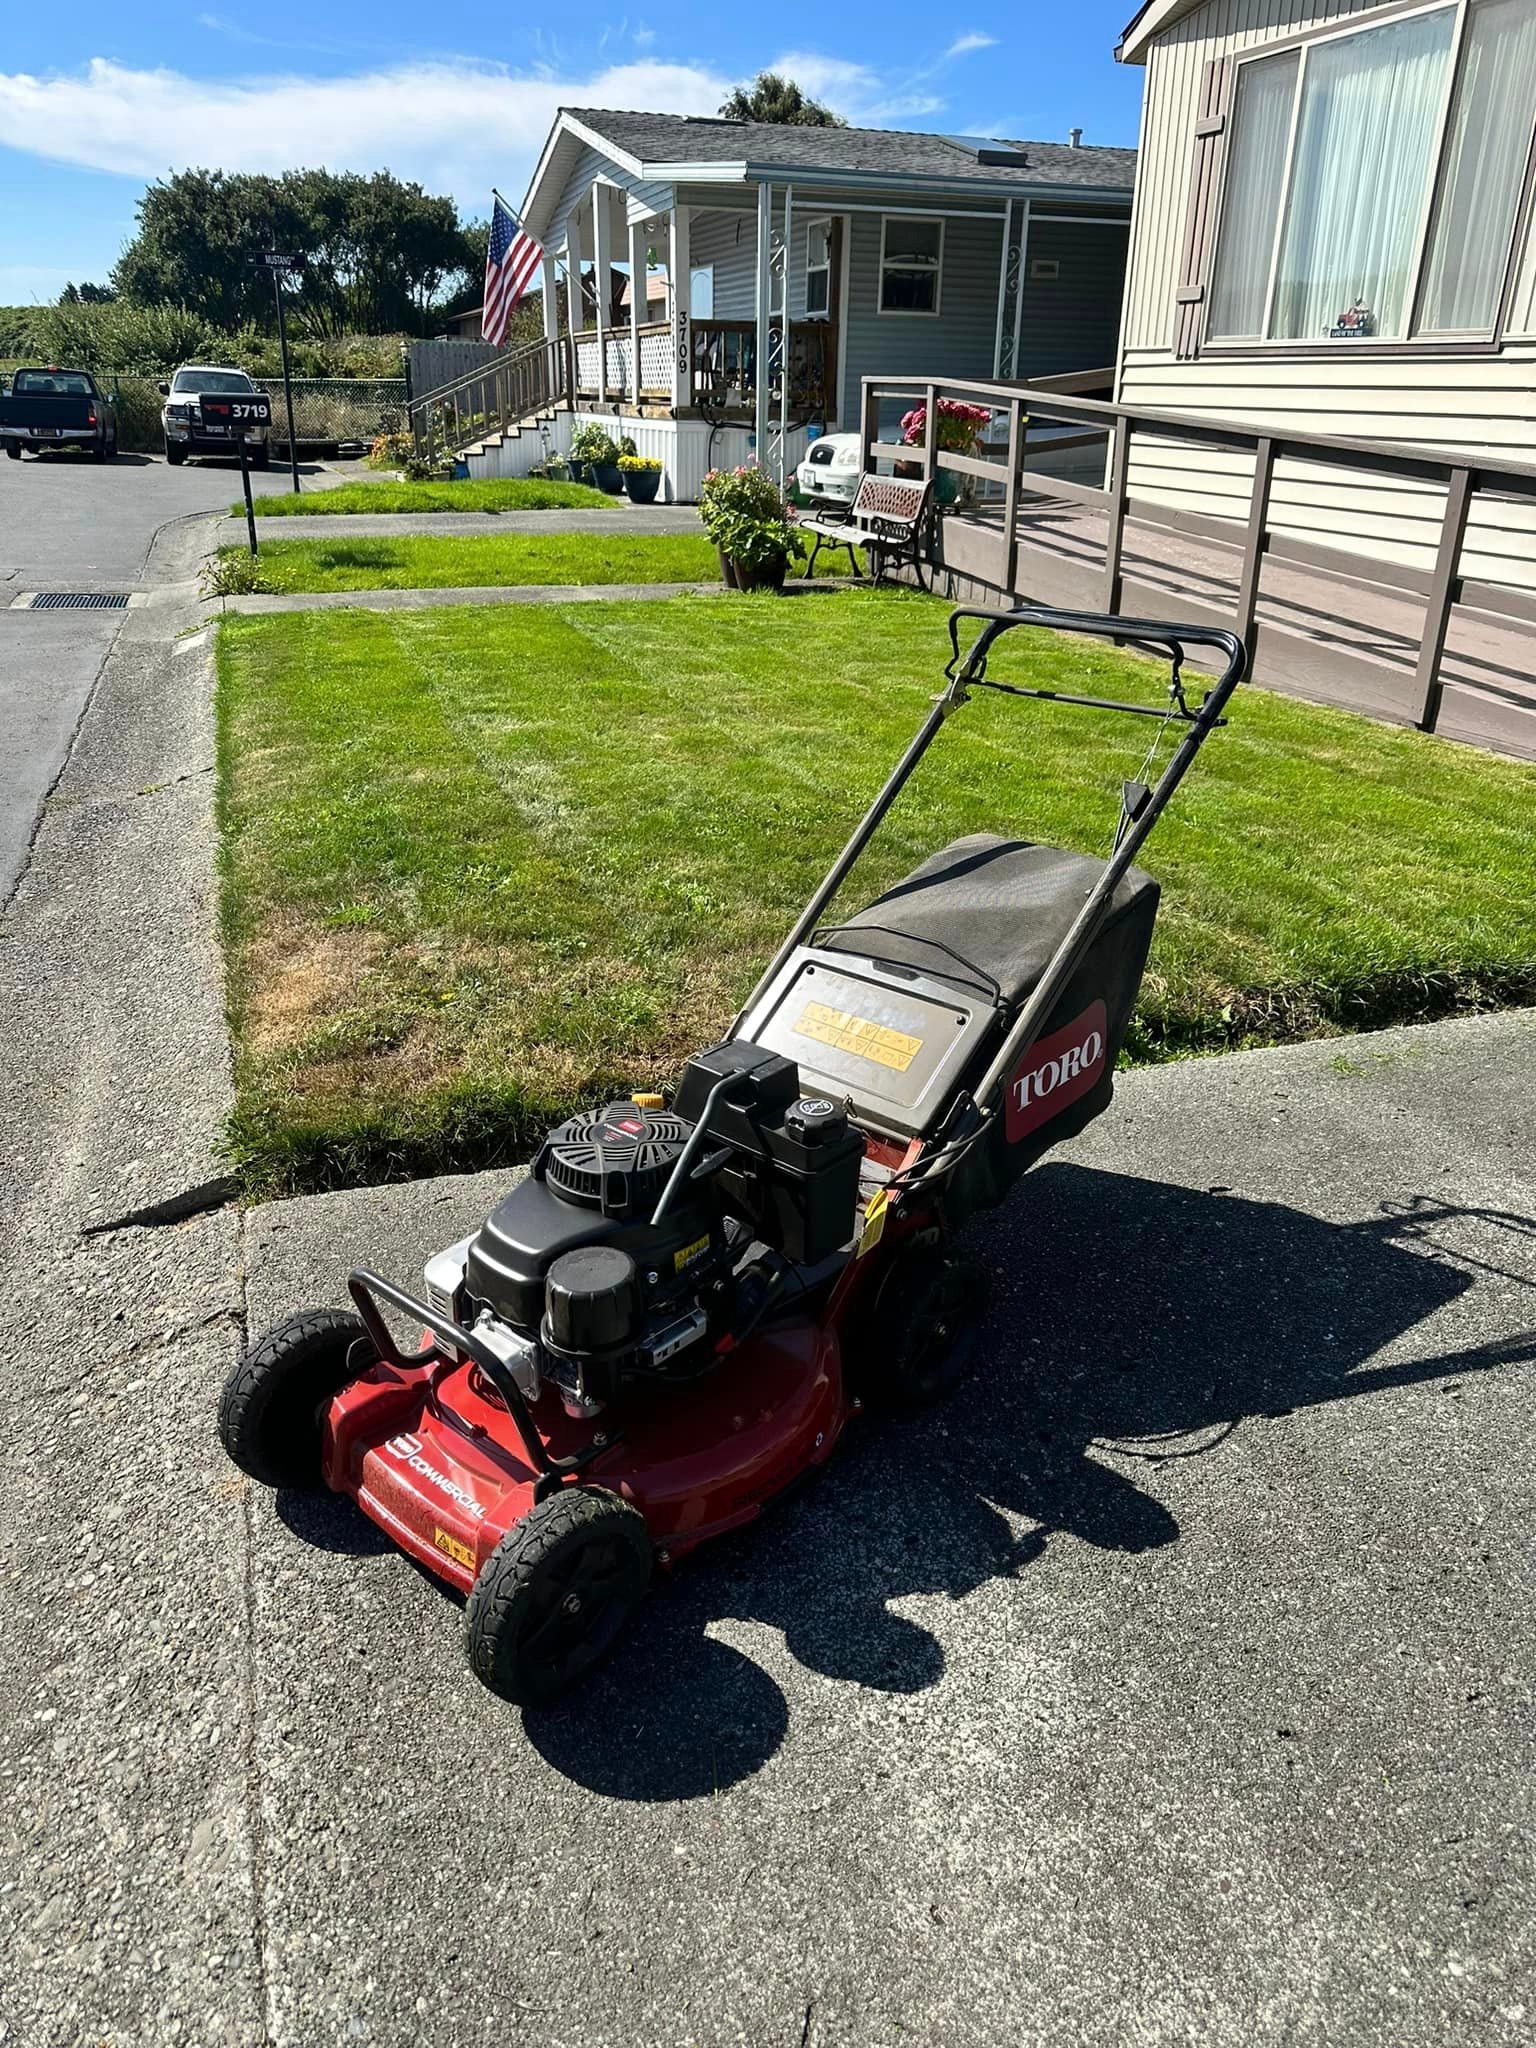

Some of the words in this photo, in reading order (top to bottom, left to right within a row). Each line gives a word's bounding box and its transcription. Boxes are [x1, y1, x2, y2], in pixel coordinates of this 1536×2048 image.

[264, 254, 292, 266] MUSTANG
[679, 311, 687, 374] 3709
[232, 404, 268, 418] 3719
[1013, 1031, 1102, 1112] TORO
[408, 1455, 487, 1520] COMMERCIAL
